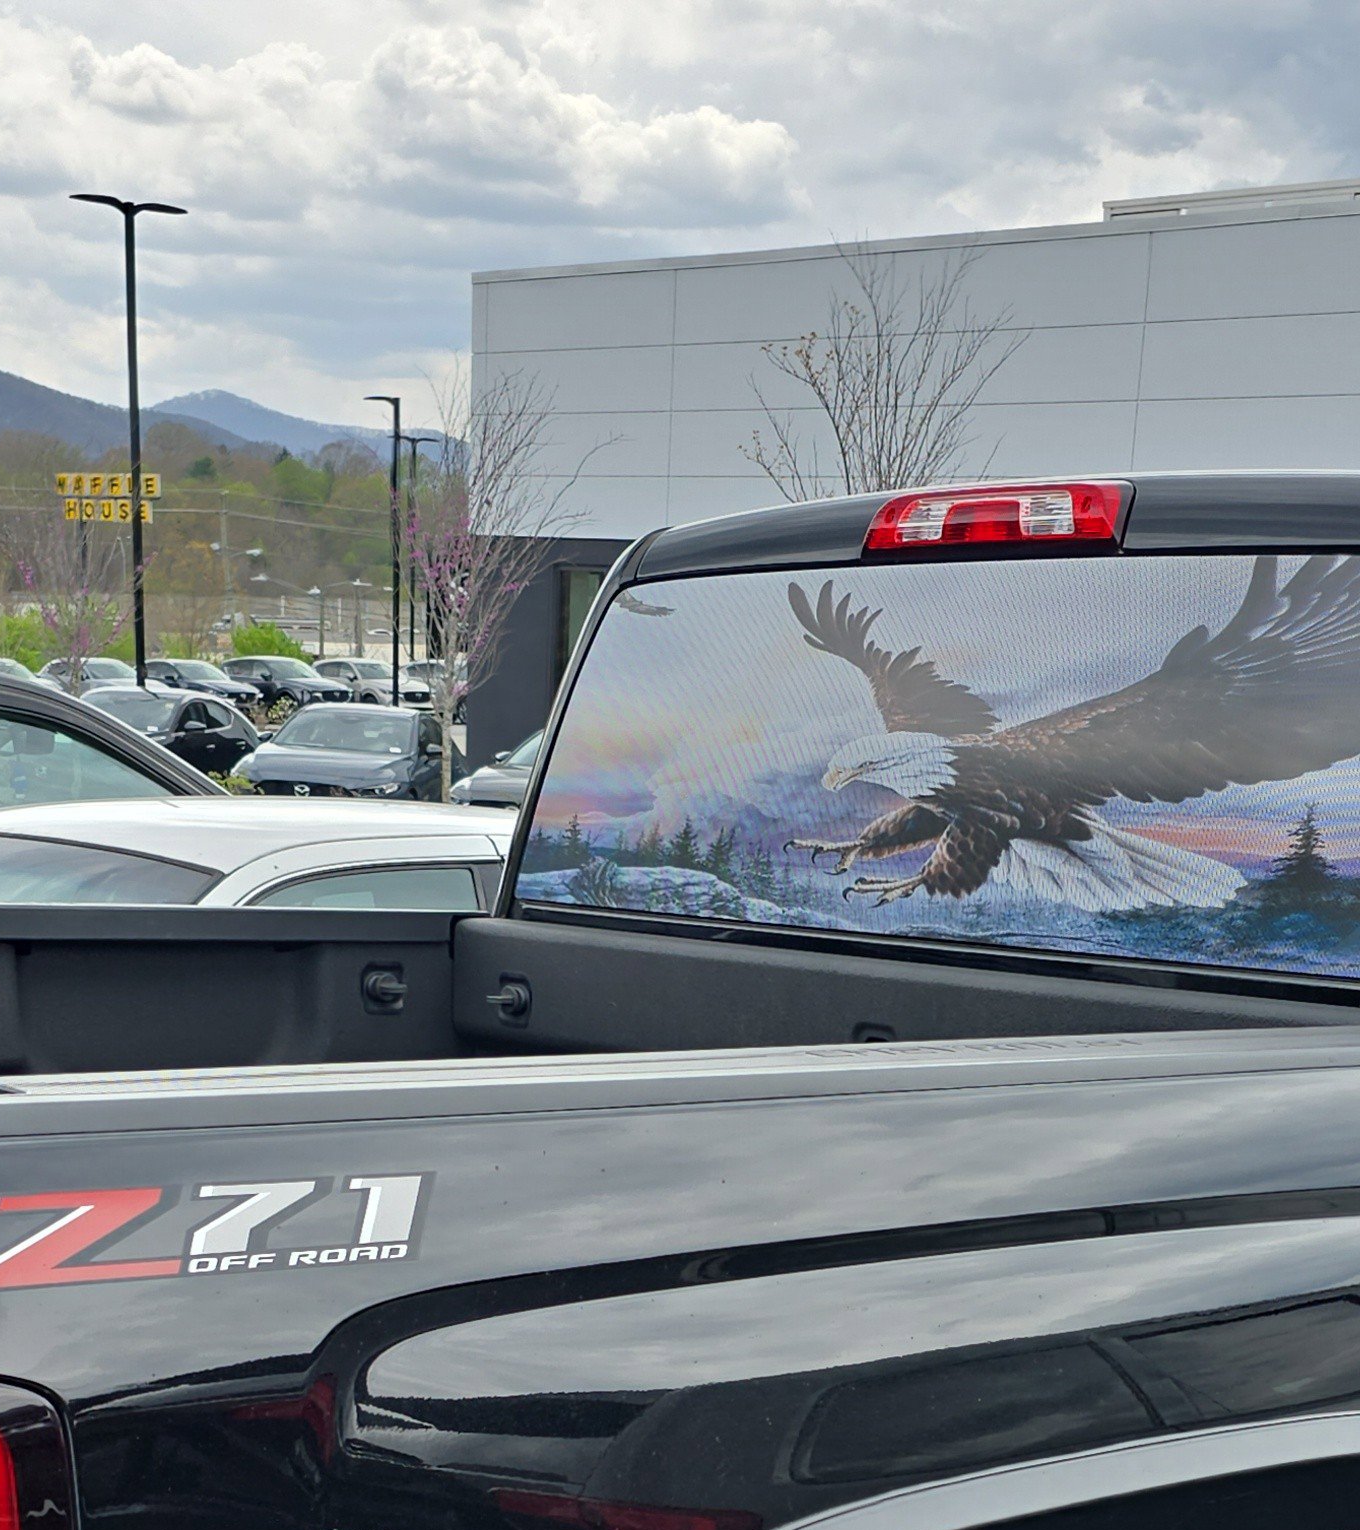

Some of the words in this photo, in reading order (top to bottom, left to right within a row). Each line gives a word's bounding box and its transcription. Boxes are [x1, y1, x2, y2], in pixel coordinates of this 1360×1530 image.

[66, 501, 147, 519] HOUSE
[187, 1252, 277, 1274] OFF
[287, 1244, 410, 1268] ROAD
